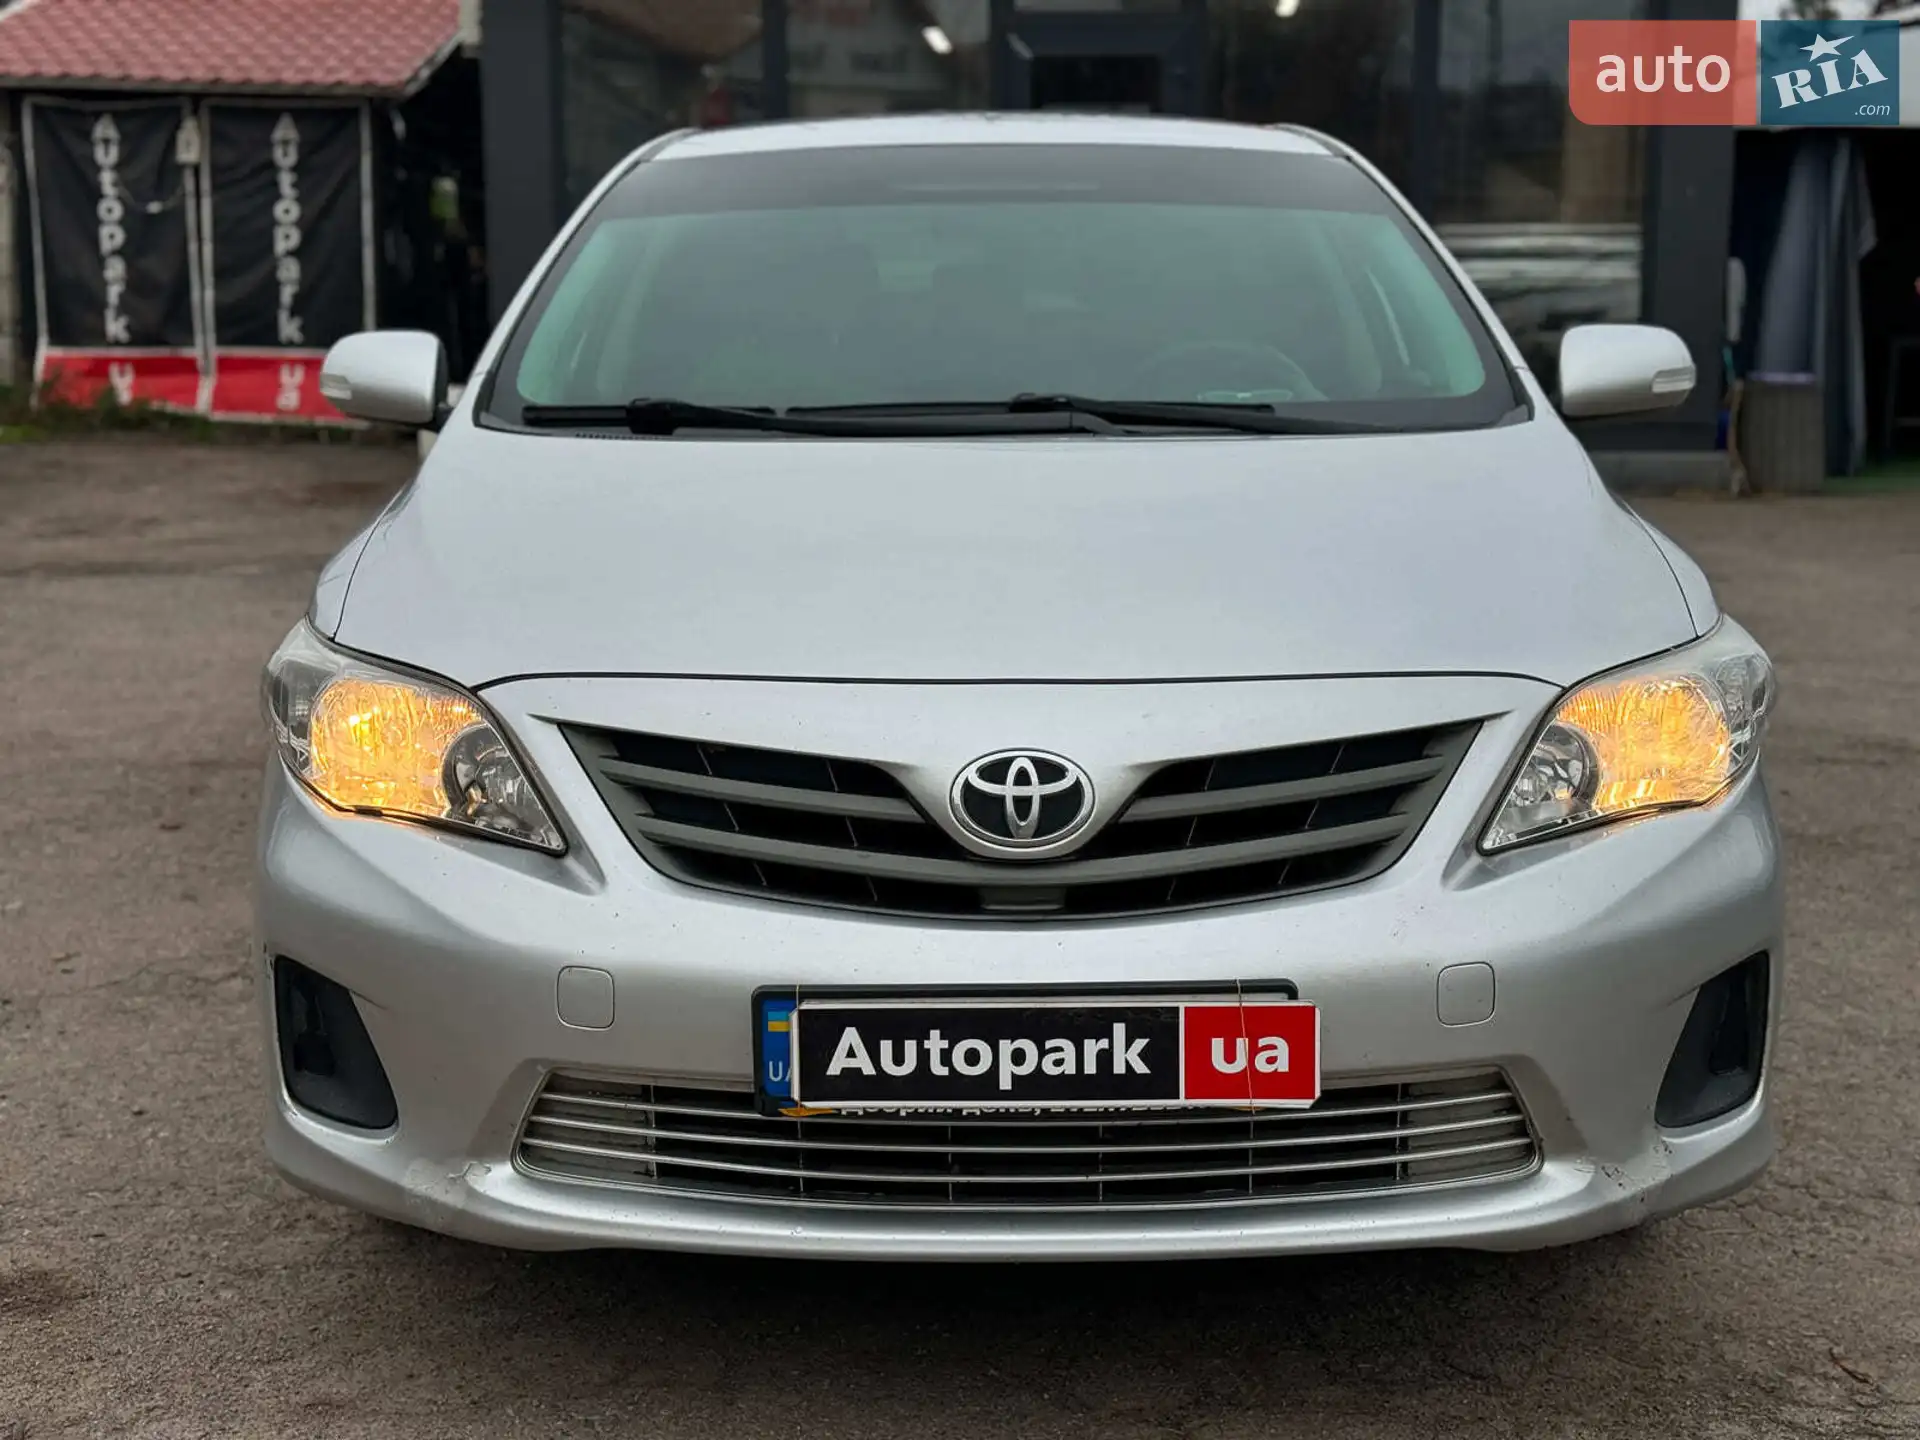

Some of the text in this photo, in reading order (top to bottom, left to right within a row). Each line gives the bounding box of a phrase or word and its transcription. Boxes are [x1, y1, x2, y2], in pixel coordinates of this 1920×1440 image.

[92, 113, 130, 343] Autopark
[271, 112, 304, 344] Autopark
[826, 1023, 1290, 1091] Autopark ua
